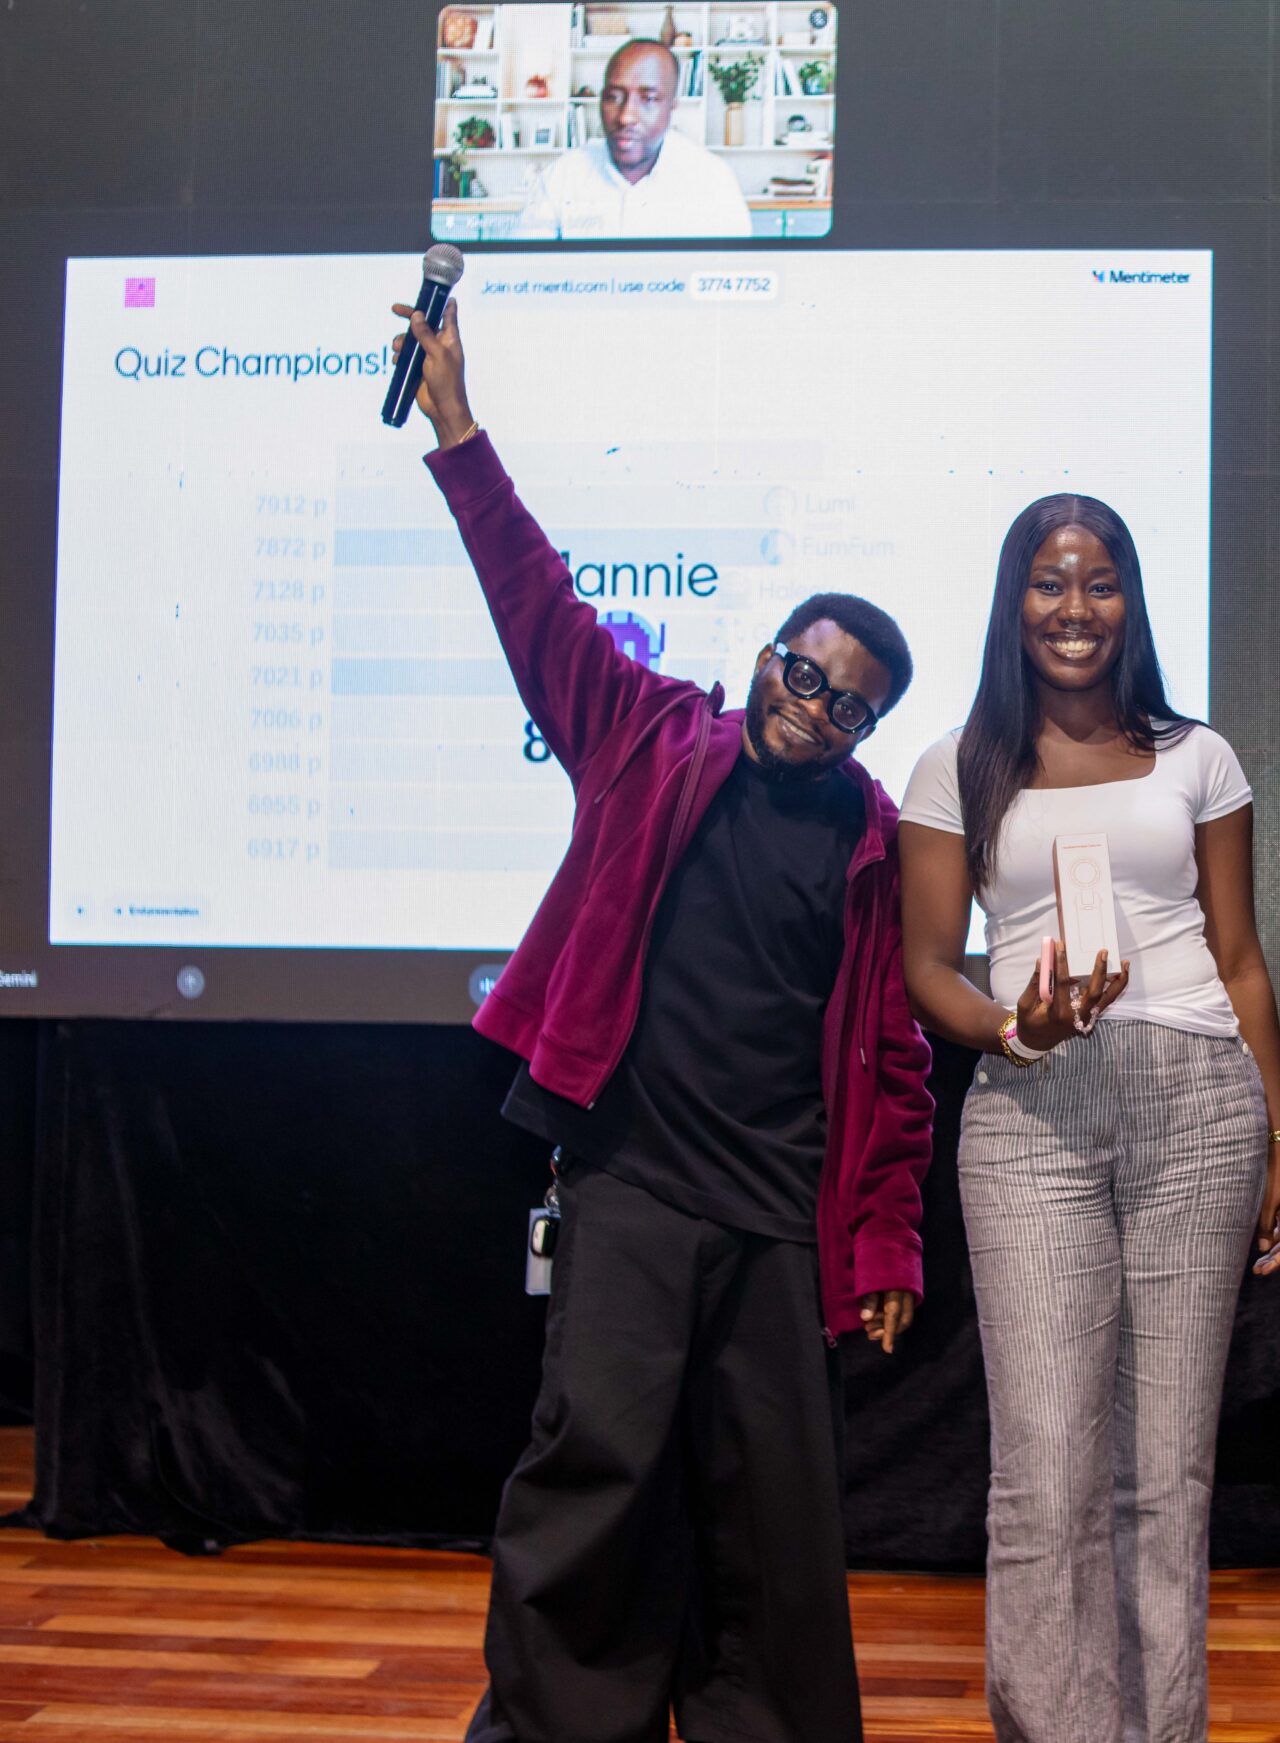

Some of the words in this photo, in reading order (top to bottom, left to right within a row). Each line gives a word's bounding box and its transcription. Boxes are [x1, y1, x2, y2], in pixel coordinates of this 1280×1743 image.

[482, 279, 510, 295] Join
[512, 280, 530, 294] at
[532, 279, 609, 294] menti.com
[618, 281, 645, 294] use
[647, 279, 687, 294] code
[698, 277, 733, 292] 3774
[736, 276, 772, 291] 7752
[1110, 270, 1191, 284] Mentimeter
[114, 347, 187, 381] Quiz
[195, 345, 388, 382] Champions!
[561, 551, 718, 597] annie
